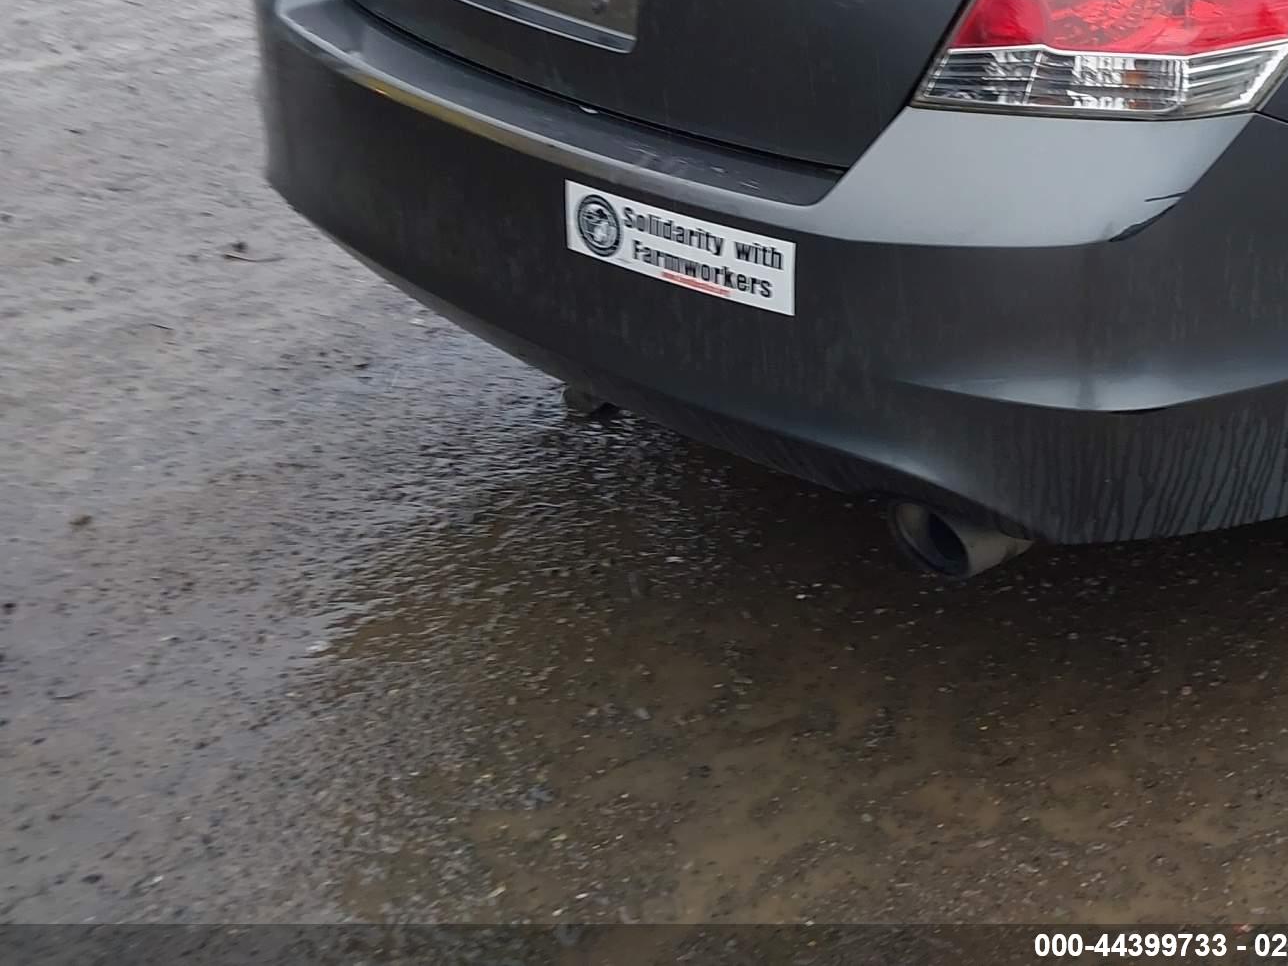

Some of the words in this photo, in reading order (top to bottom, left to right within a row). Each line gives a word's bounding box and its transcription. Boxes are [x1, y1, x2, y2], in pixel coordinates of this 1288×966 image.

[623, 206, 724, 257] Solidarity
[734, 240, 783, 270] with
[632, 240, 772, 299] Farmworkers
